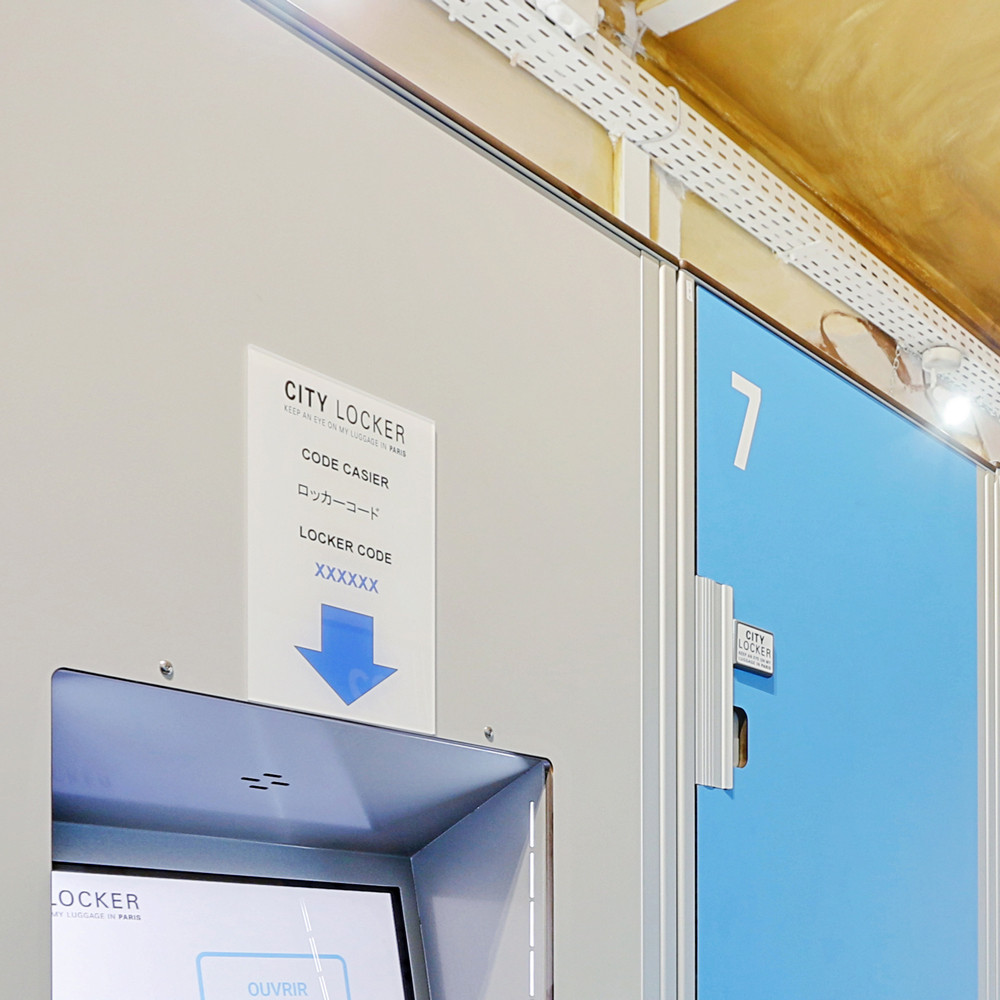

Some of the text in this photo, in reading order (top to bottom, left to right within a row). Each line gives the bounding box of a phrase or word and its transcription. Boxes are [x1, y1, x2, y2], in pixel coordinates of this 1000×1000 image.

[284, 380, 405, 444] CITY LOCKER
[731, 370, 762, 471] 7
[284, 404, 301, 415] KEEP
[302, 412, 312, 421] AN
[314, 415, 326, 427] EYE
[328, 421, 337, 431] ON
[339, 426, 349, 436] MY
[389, 445, 407, 458] PARIS
[301, 448, 390, 489] CODE CASIER
[298, 483, 380, 520] ロッカーコード
[299, 525, 392, 565] LOCKER CODE
[315, 562, 379, 594] XXXXXX
[738, 638, 771, 658] LOCKER
[746, 630, 765, 645] CITY
[66, 911, 105, 920] LUGGAGE
[248, 982, 308, 997] OUVRIR
